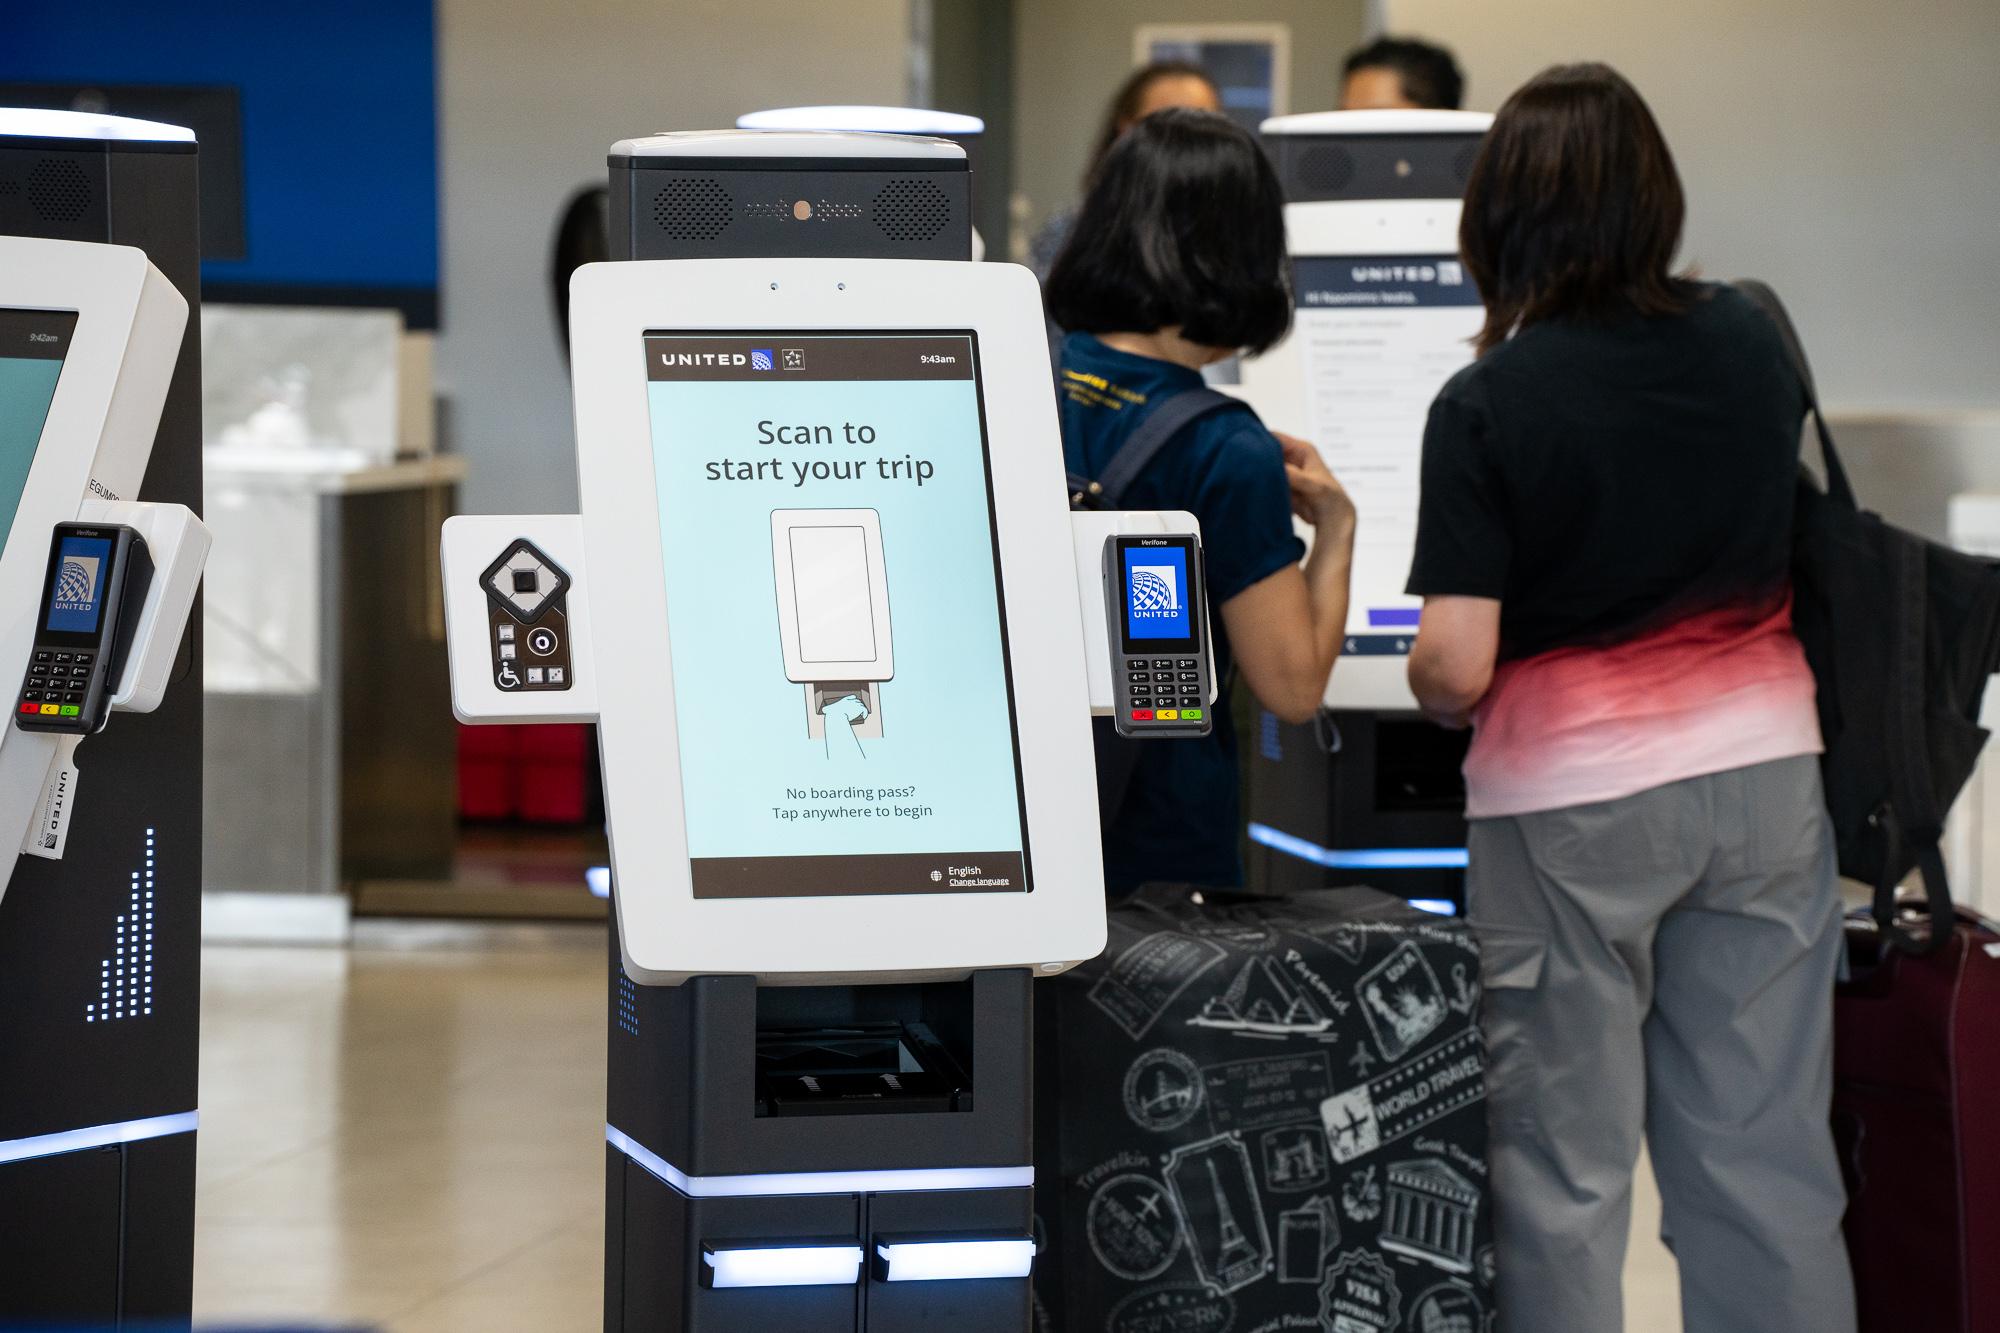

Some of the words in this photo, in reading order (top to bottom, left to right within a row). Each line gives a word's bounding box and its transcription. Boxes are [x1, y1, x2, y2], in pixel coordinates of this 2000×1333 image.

[1351, 266, 1436, 282] UNITED
[30, 333, 58, 342] 9:42am
[662, 353, 746, 366] UNITED
[921, 355, 956, 364] 9:43am
[757, 420, 833, 445] Scan
[842, 422, 876, 444] to
[705, 458, 784, 481] start
[791, 461, 867, 488] your
[876, 454, 934, 486] trip
[55, 602, 92, 611] UNITED
[51, 771, 68, 830] UNITED
[786, 788, 807, 799] No
[810, 786, 874, 801] boarding
[878, 786, 916, 801] pass?
[772, 807, 799, 822] Tap
[802, 806, 872, 822] anywhere
[876, 806, 890, 817] to
[894, 805, 933, 820] begin
[948, 866, 982, 878] English
[949, 878, 976, 886] Change
[977, 878, 1010, 886] language
[1374, 1080, 1431, 1120] WORLD
